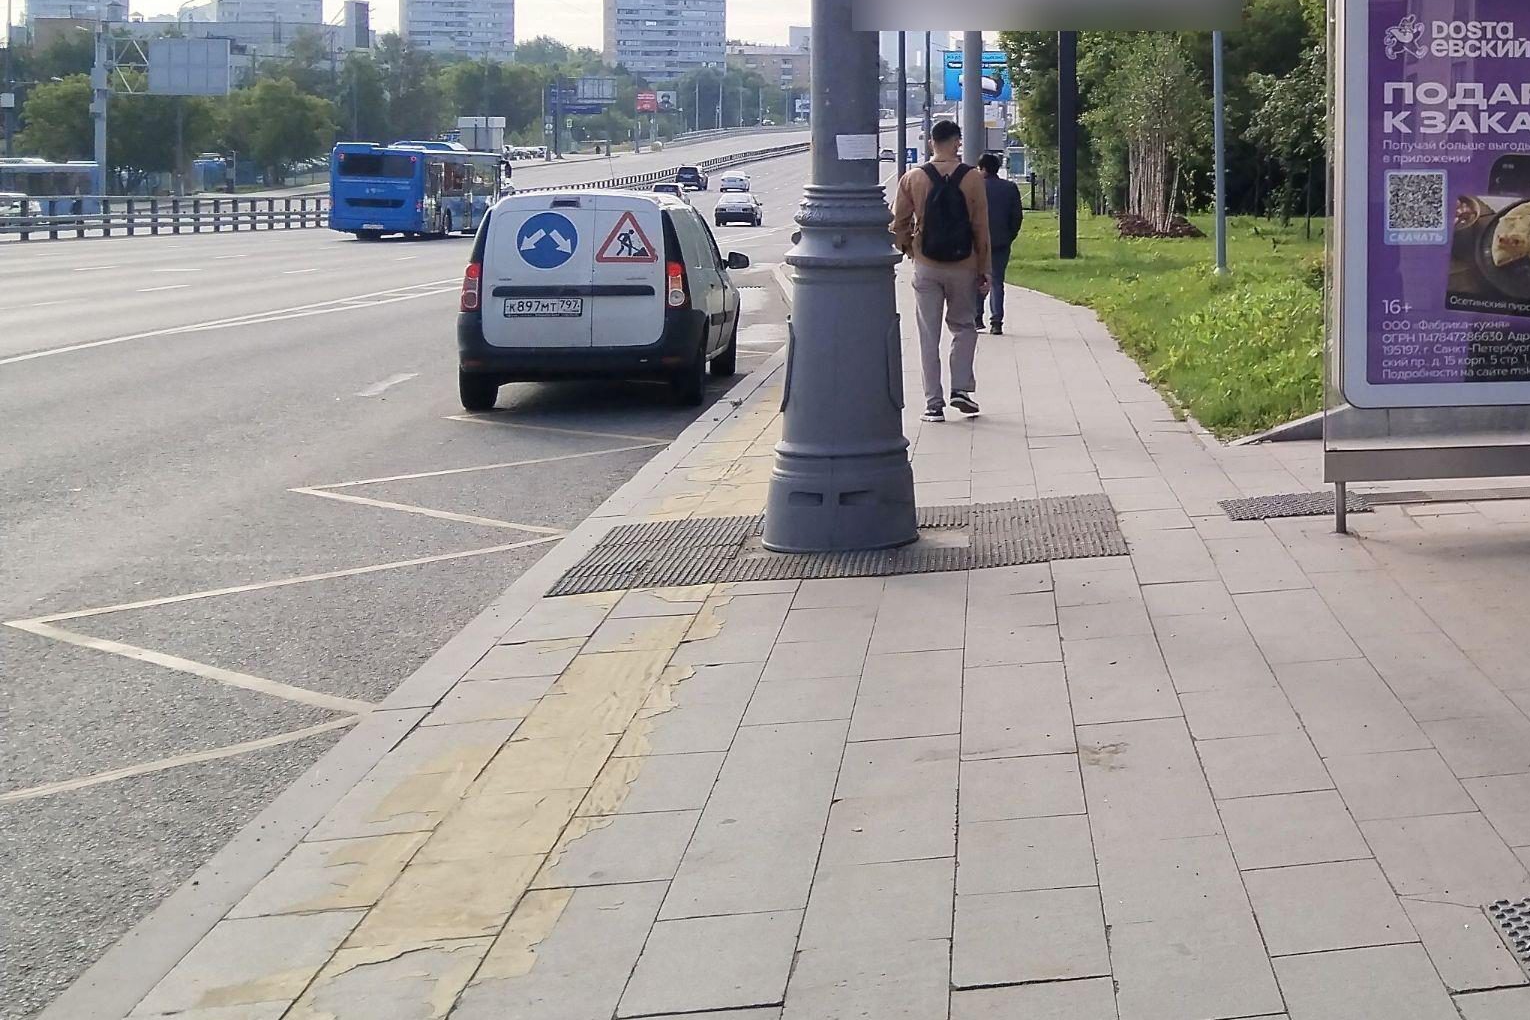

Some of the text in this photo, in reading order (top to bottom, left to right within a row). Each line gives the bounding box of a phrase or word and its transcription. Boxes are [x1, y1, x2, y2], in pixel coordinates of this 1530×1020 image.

[1383, 110, 1412, 134] К
[1382, 140, 1436, 152] Получай
[1439, 140, 1486, 151] больше
[1382, 154, 1472, 165] в приложении
[1382, 299, 1412, 314] 16+
[1450, 295, 1506, 309] Осетинский
[1382, 320, 1411, 330] ООО
[1382, 333, 1416, 343] ОГРН
[1382, 357, 1409, 367] ский
[1444, 355, 1456, 365] 15
[1490, 355, 1498, 365] 5
[1382, 368, 1458, 380] Подробности
[1460, 368, 1474, 377] на
[1476, 366, 1508, 377] сайте
